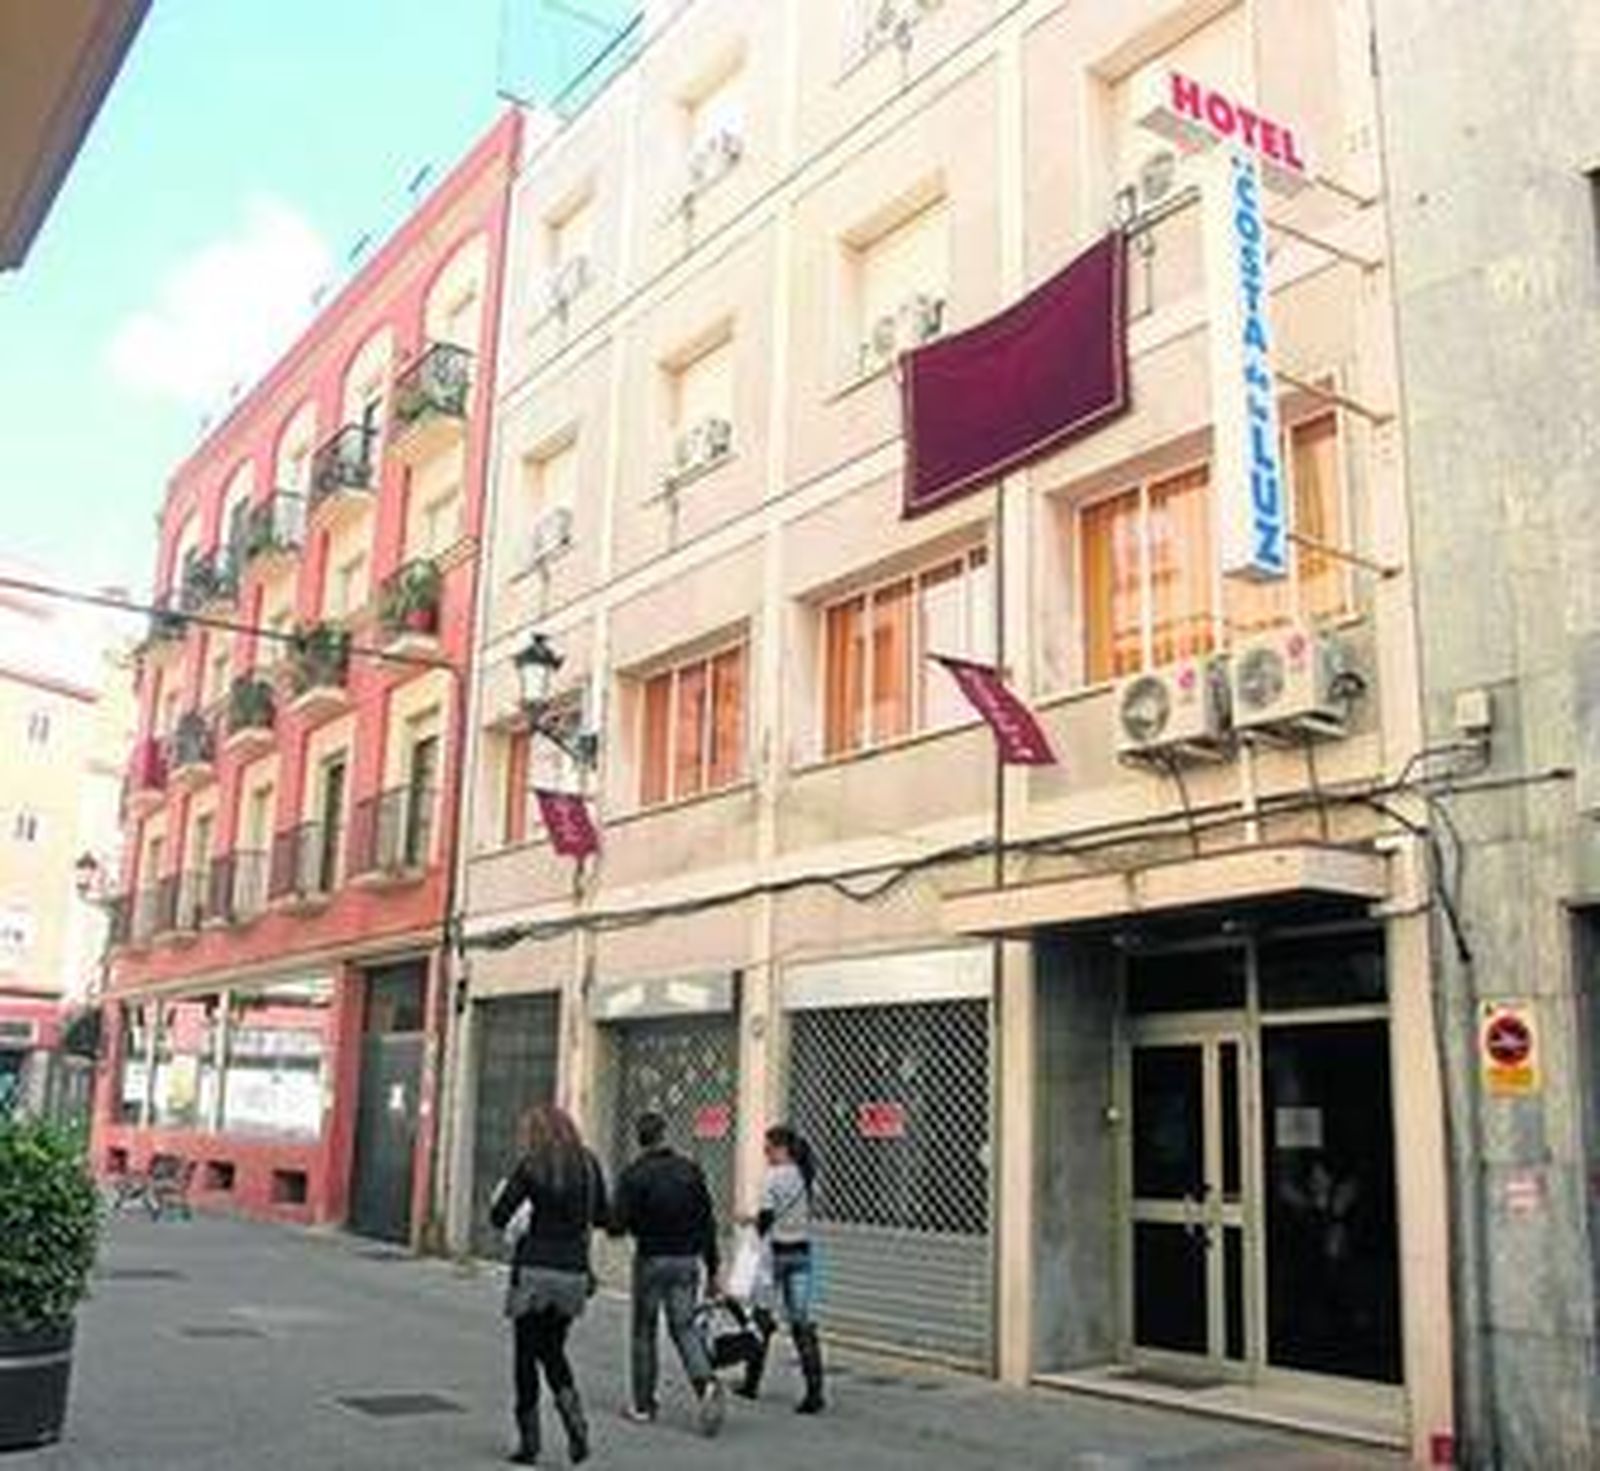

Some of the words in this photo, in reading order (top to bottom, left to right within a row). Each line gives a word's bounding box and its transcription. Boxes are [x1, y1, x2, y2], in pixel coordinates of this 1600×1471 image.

[1171, 72, 1304, 171] HOTEL
[1236, 176, 1267, 353] COSTA
[1252, 425, 1281, 566] LUZ
